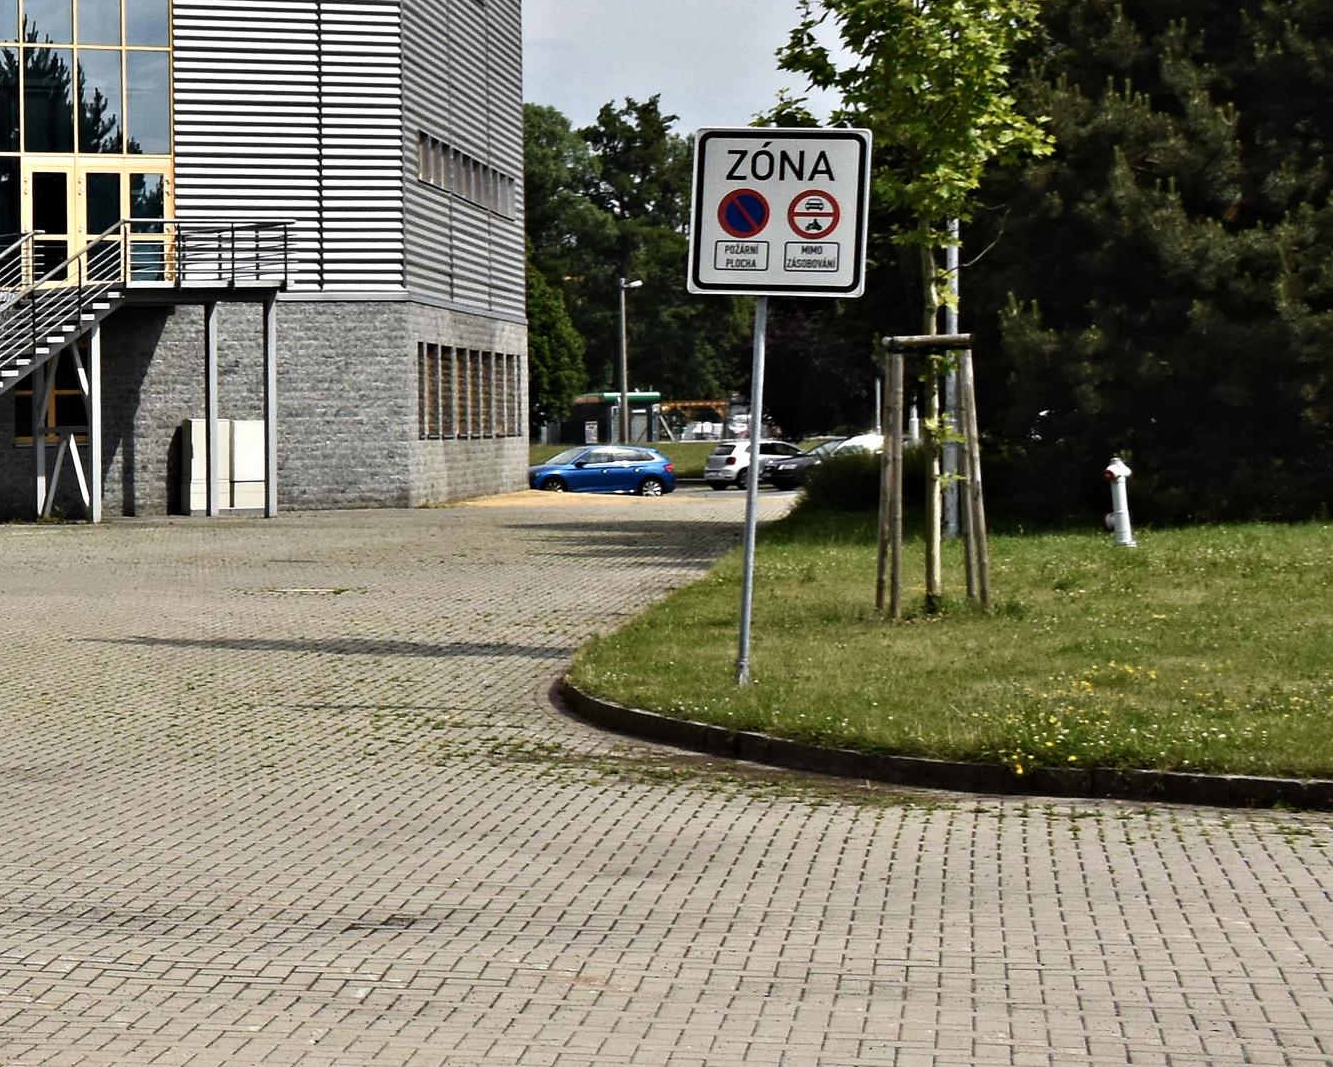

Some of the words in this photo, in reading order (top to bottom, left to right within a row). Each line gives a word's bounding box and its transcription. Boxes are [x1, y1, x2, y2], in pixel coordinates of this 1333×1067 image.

[725, 141, 835, 181] ZÓNA
[724, 243, 759, 255] POŽÁRNÍ
[801, 245, 823, 255] MIMO
[725, 258, 757, 268] PLOCHA
[786, 257, 836, 269] ZÁSOBOVÁNÍ
